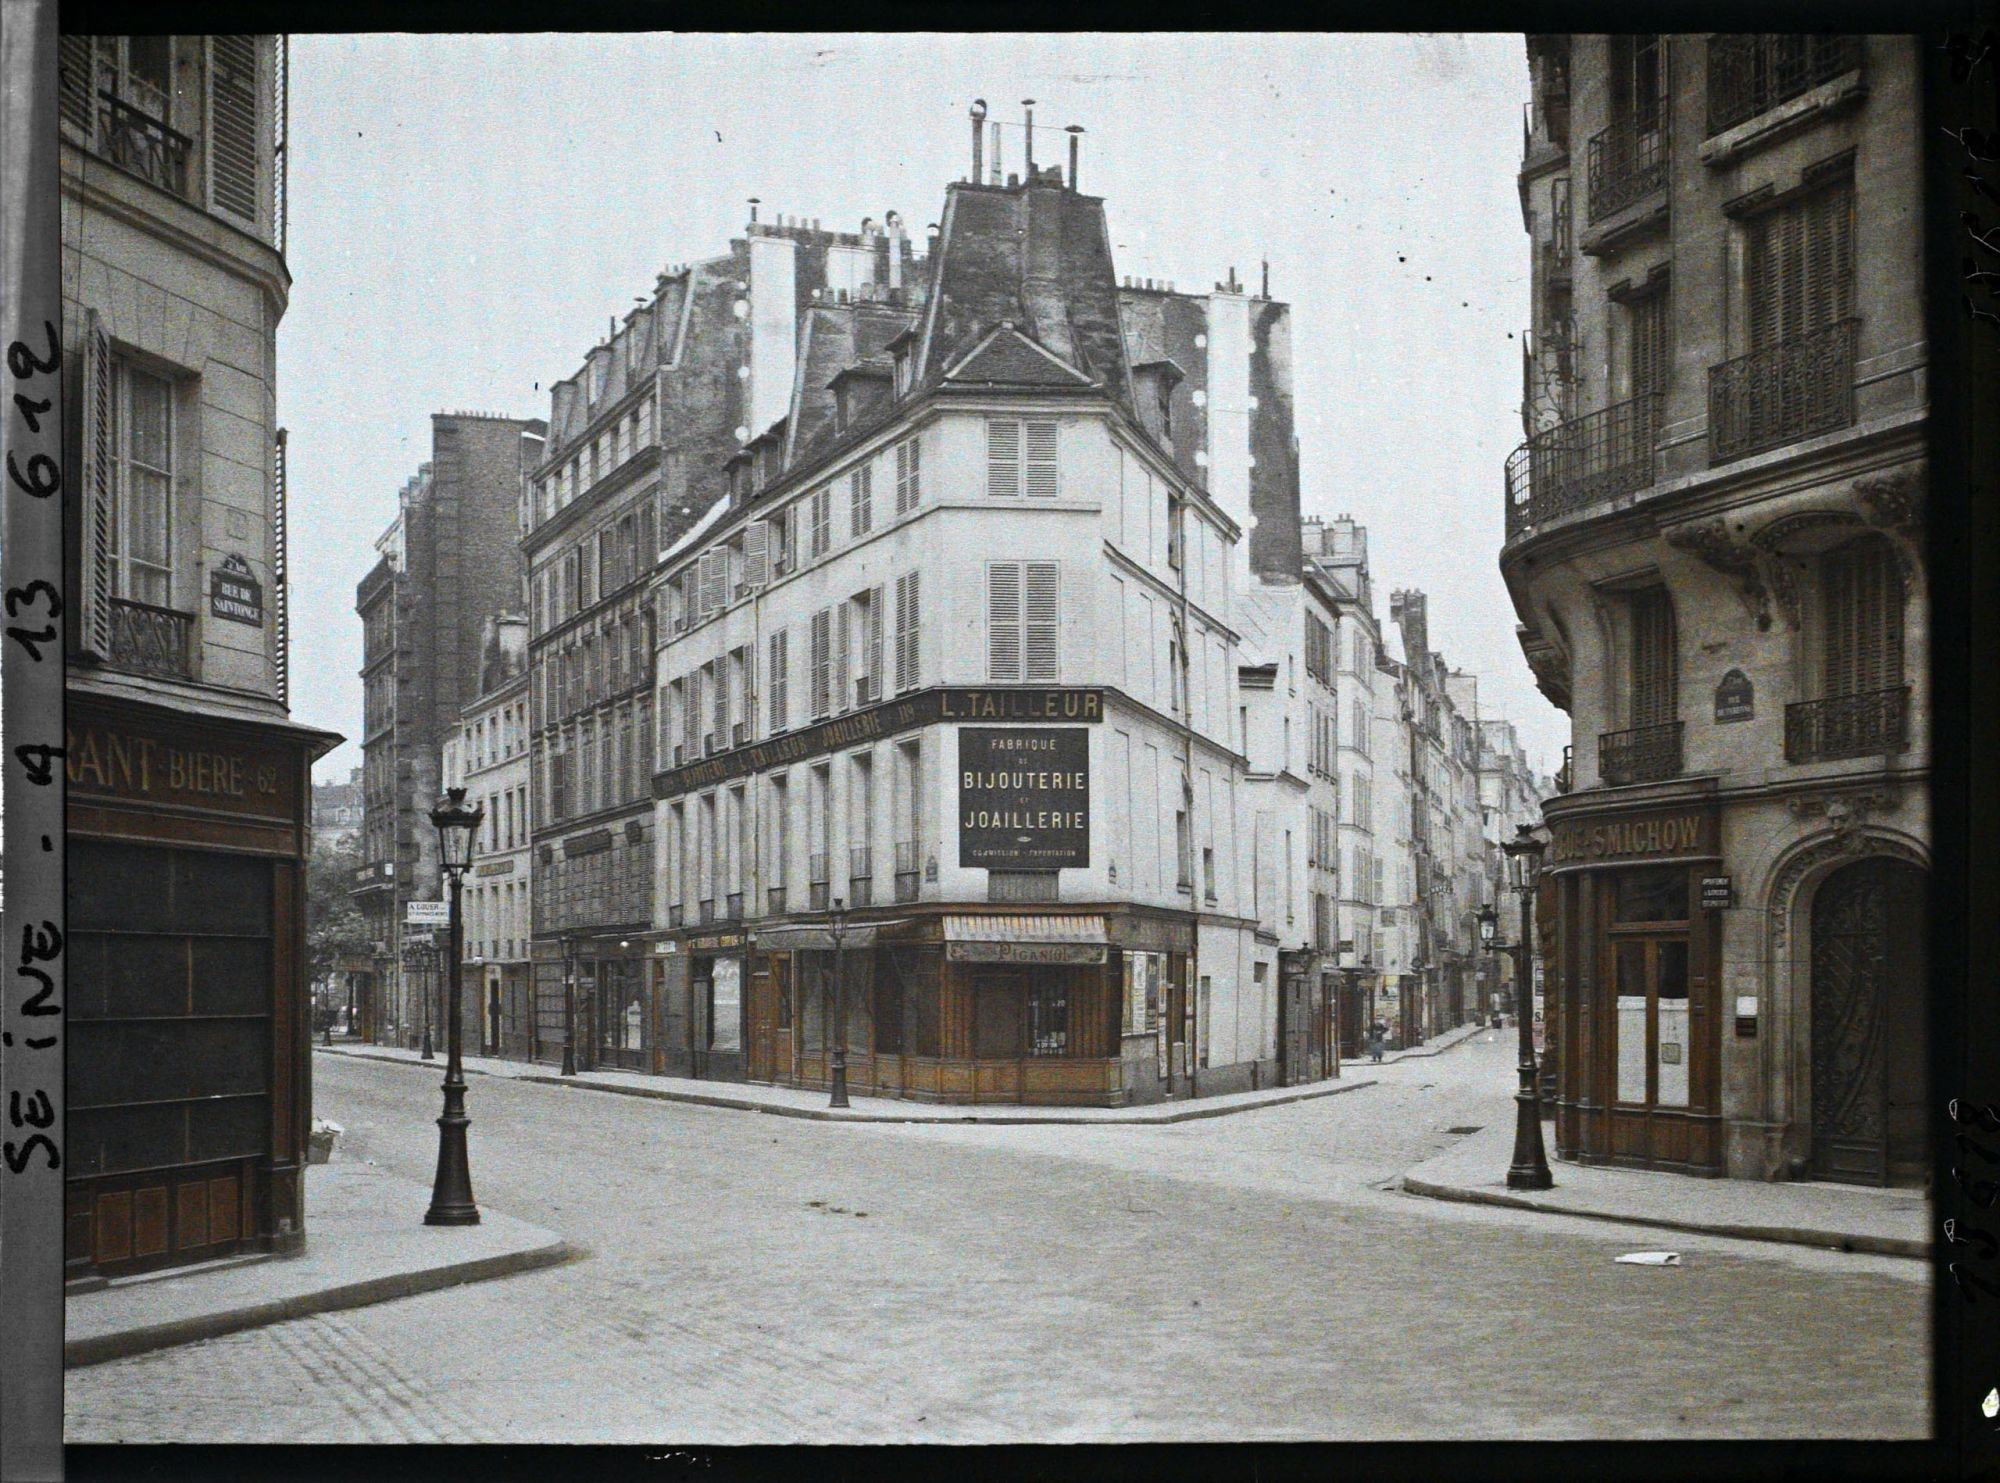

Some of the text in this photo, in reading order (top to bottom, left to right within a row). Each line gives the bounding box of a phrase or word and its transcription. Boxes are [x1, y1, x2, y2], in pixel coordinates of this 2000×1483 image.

[7, 320, 61, 499] 612
[221, 582, 240, 598] RUE
[6, 579, 61, 662] 13
[821, 712, 882, 747] JOAILLERIE
[991, 739, 1056, 751] FABRIQUE
[963, 772, 1085, 790] BIJOUTERIE
[965, 811, 1085, 829] JOAILLERIE
[1592, 815, 1701, 857] SMICHOW
